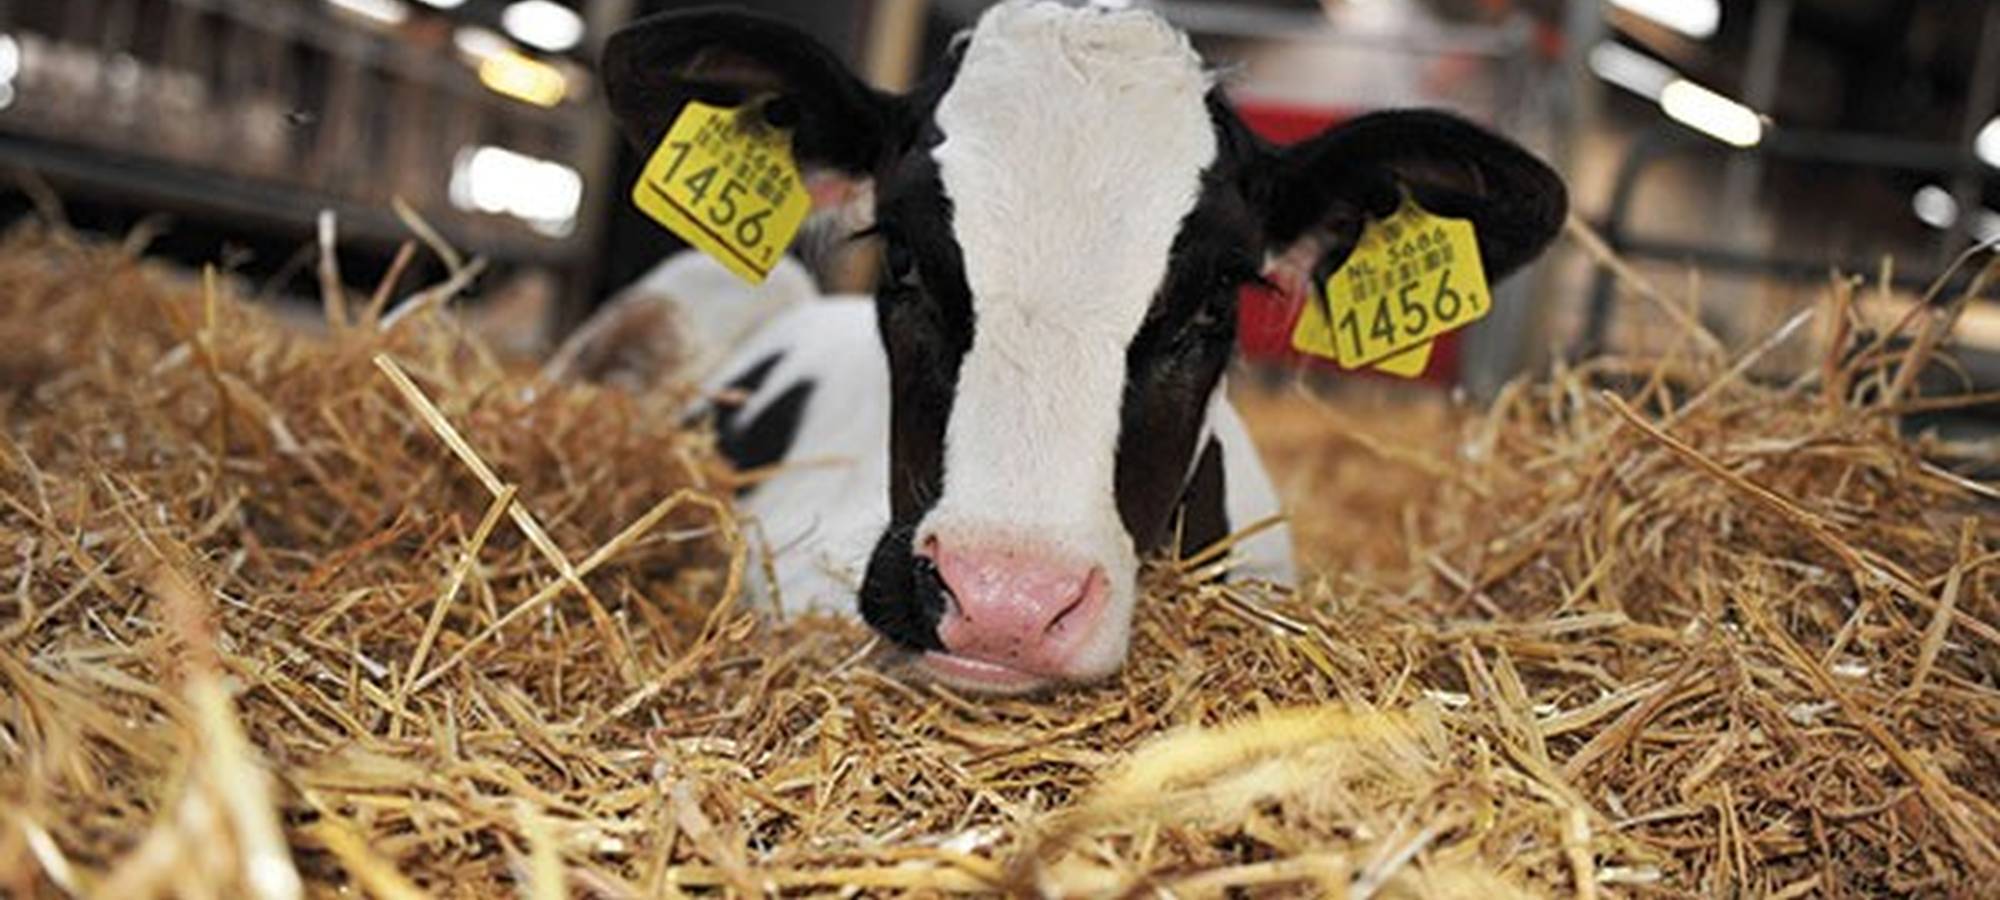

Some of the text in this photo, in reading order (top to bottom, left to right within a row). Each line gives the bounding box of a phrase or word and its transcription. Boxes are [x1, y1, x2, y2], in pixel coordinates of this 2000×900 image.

[664, 141, 773, 248] 1456
[1339, 269, 1461, 357] 1456
[1348, 257, 1376, 281] NL
